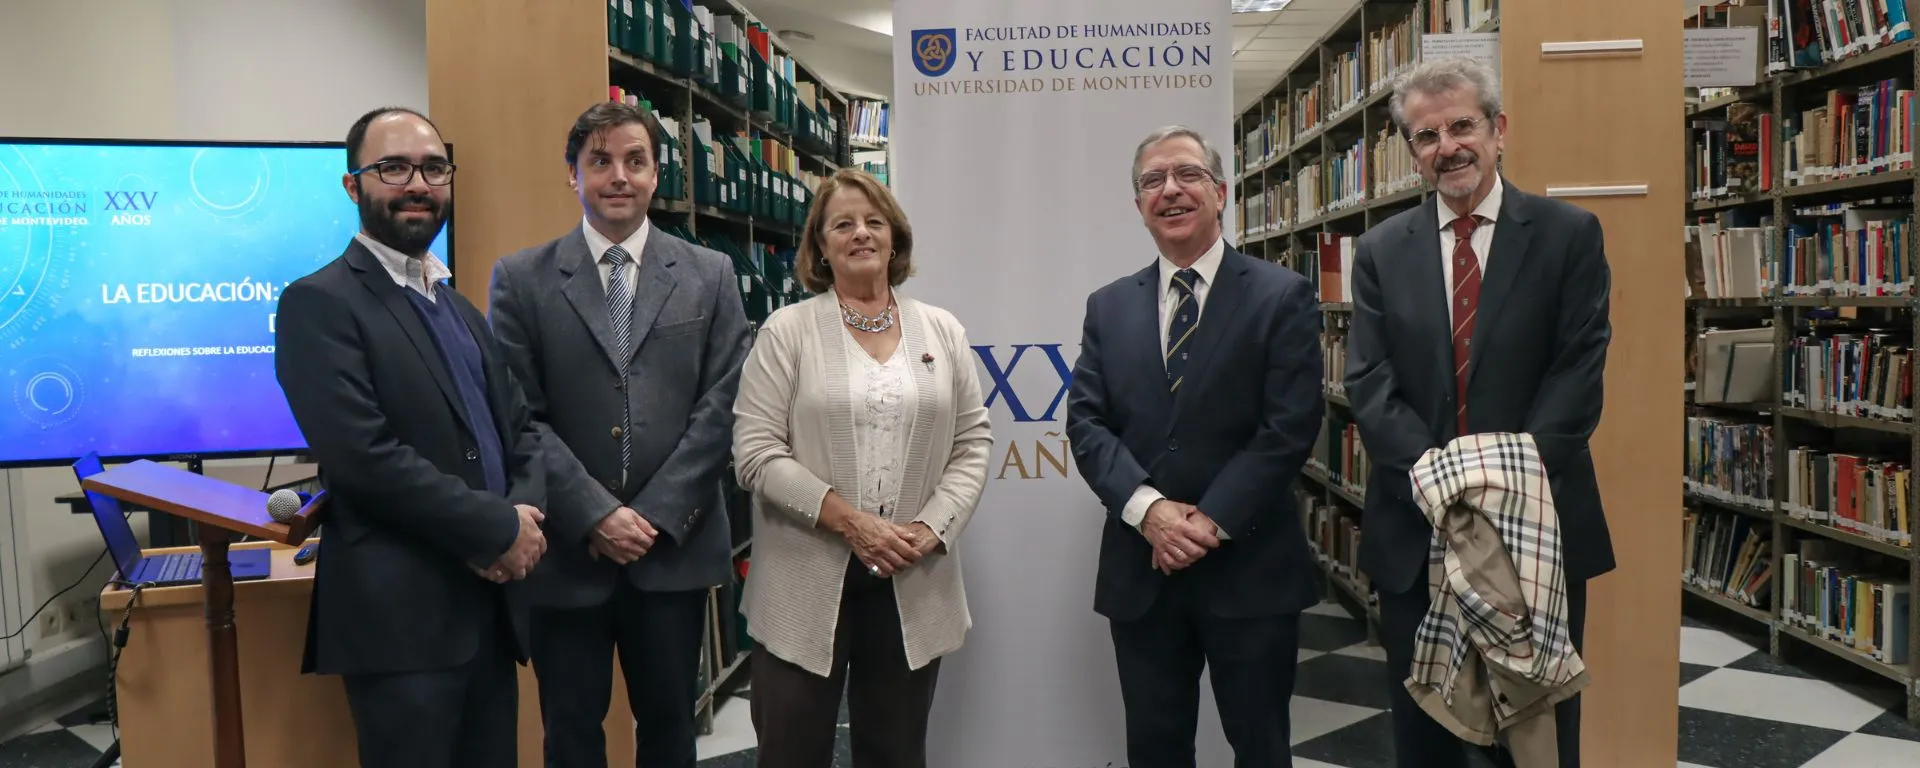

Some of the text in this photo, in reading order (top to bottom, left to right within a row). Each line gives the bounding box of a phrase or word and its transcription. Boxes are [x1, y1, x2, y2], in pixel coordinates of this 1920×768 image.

[966, 22, 1212, 42] FACULTAD DE HUMANIDADES
[966, 41, 1212, 72] Y EDUCACIÓN
[913, 74, 1213, 97] UNIVERSIDAD DE MONTEVIDEO
[12, 190, 87, 199] HUMANIDADES
[104, 191, 158, 211] XXV
[0, 200, 87, 214] CACIÓN
[12, 217, 88, 225] MONTEVIDEO
[111, 212, 152, 225] AÑOS
[102, 277, 280, 304] LA EDUCACIÓN:
[132, 347, 191, 357] REFLEXIONES
[192, 347, 222, 356] SOBRE
[224, 346, 235, 355] LA
[970, 343, 1082, 422] XX
